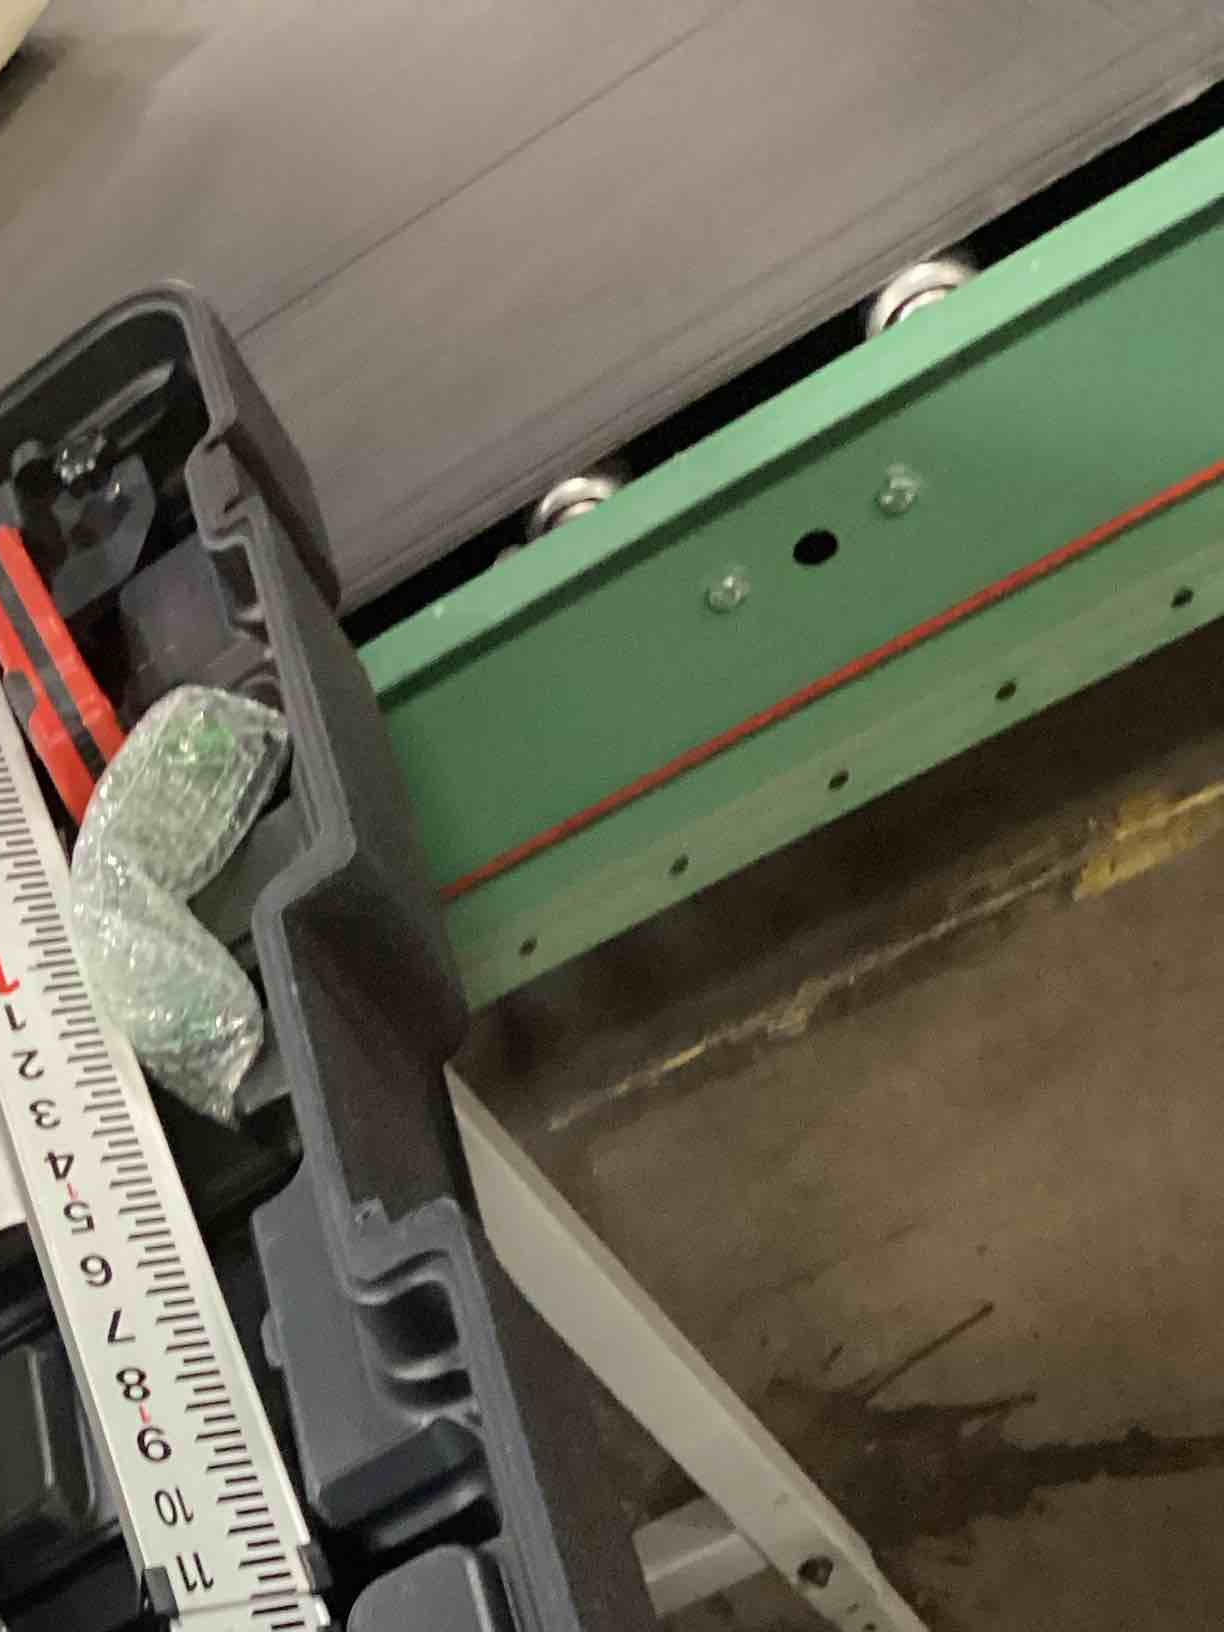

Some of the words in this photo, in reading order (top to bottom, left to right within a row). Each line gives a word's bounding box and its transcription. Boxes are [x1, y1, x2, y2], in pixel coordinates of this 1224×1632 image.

[4, 1004, 26, 1031] 1
[12, 1049, 45, 1080] 2
[28, 1099, 61, 1129] 3
[44, 1151, 75, 1181] 4
[63, 1201, 95, 1235] 5
[79, 1254, 113, 1287] 6
[107, 1307, 136, 1345] 7
[115, 1367, 151, 1402] 8
[136, 1425, 173, 1462] 9
[154, 1487, 194, 1527] 10
[176, 1552, 215, 1594] 11
